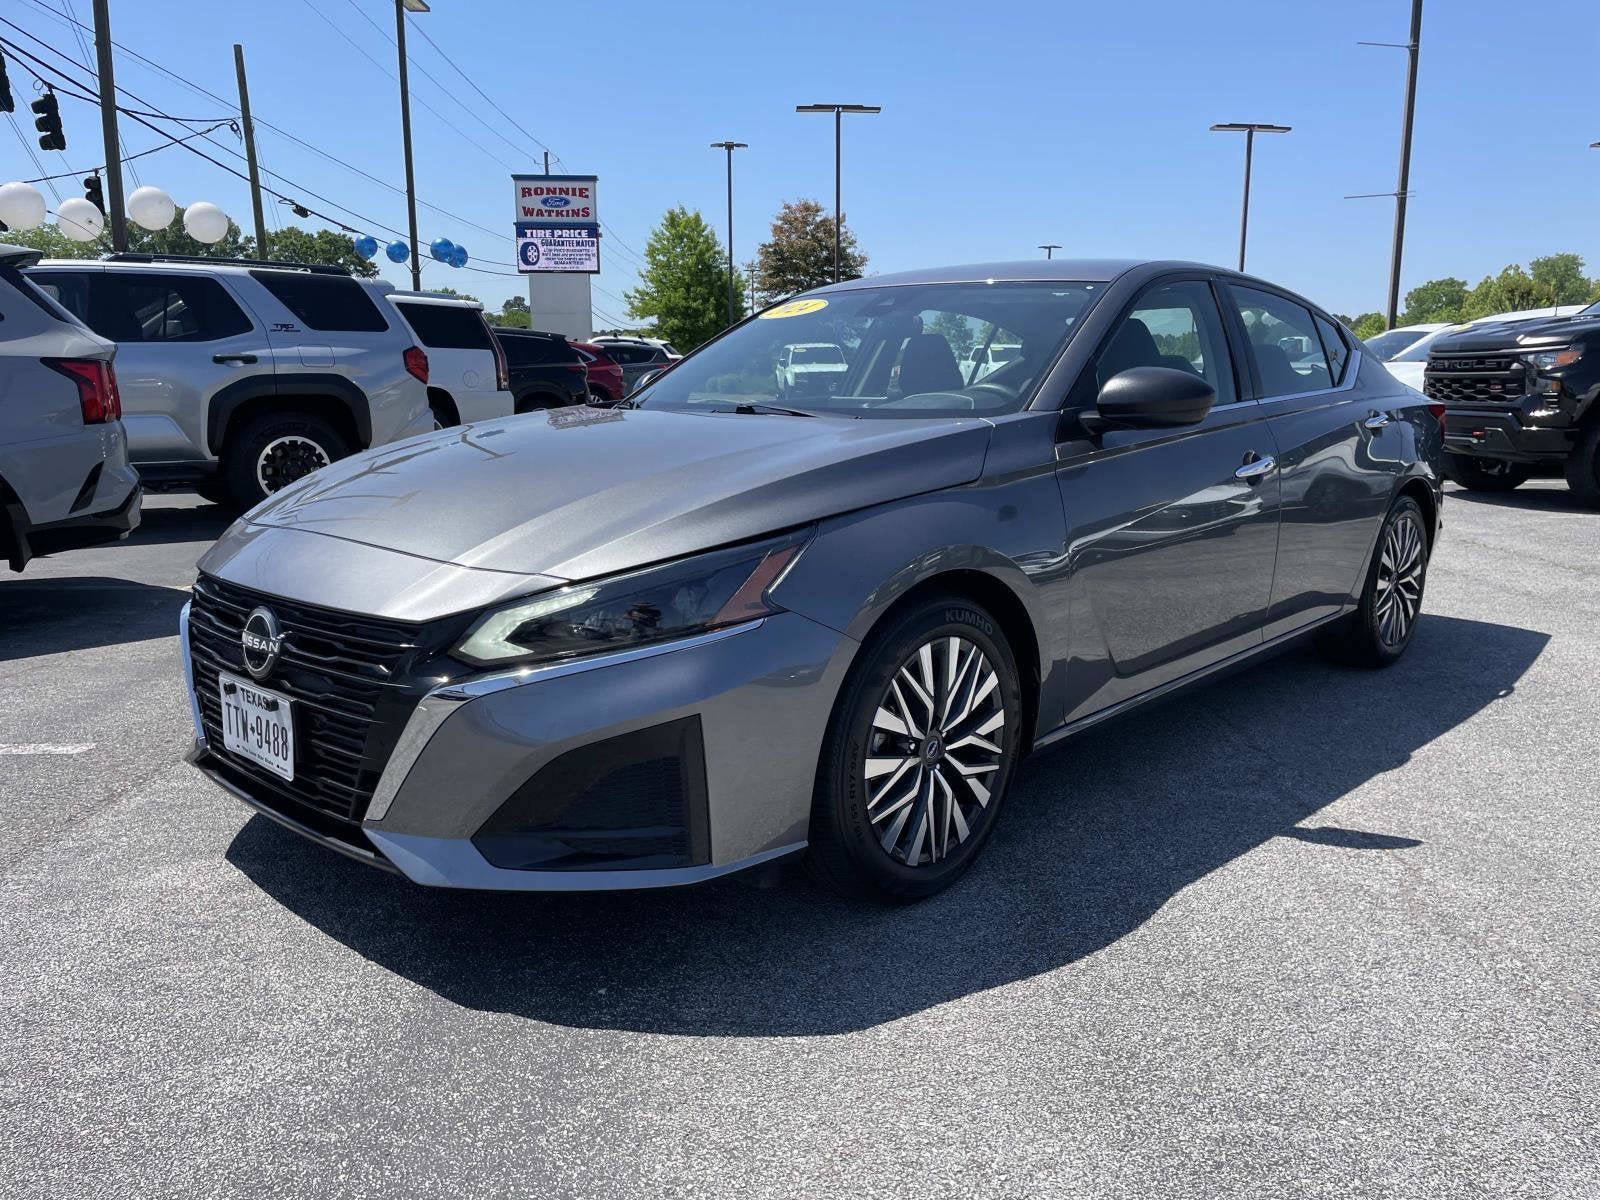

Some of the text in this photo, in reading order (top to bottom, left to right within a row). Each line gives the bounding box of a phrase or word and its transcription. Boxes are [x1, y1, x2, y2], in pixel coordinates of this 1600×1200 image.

[521, 187, 589, 199] RONNIE
[546, 199, 565, 207] Ford
[522, 206, 590, 218] WATKINS
[525, 229, 588, 238] TIRE PRICE
[541, 239, 595, 248] GUARANTEE MATCH
[945, 609, 993, 634] KUMHO
[242, 630, 279, 653] SSAN
[240, 687, 268, 710] TEXAS
[255, 715, 288, 761] 9488
